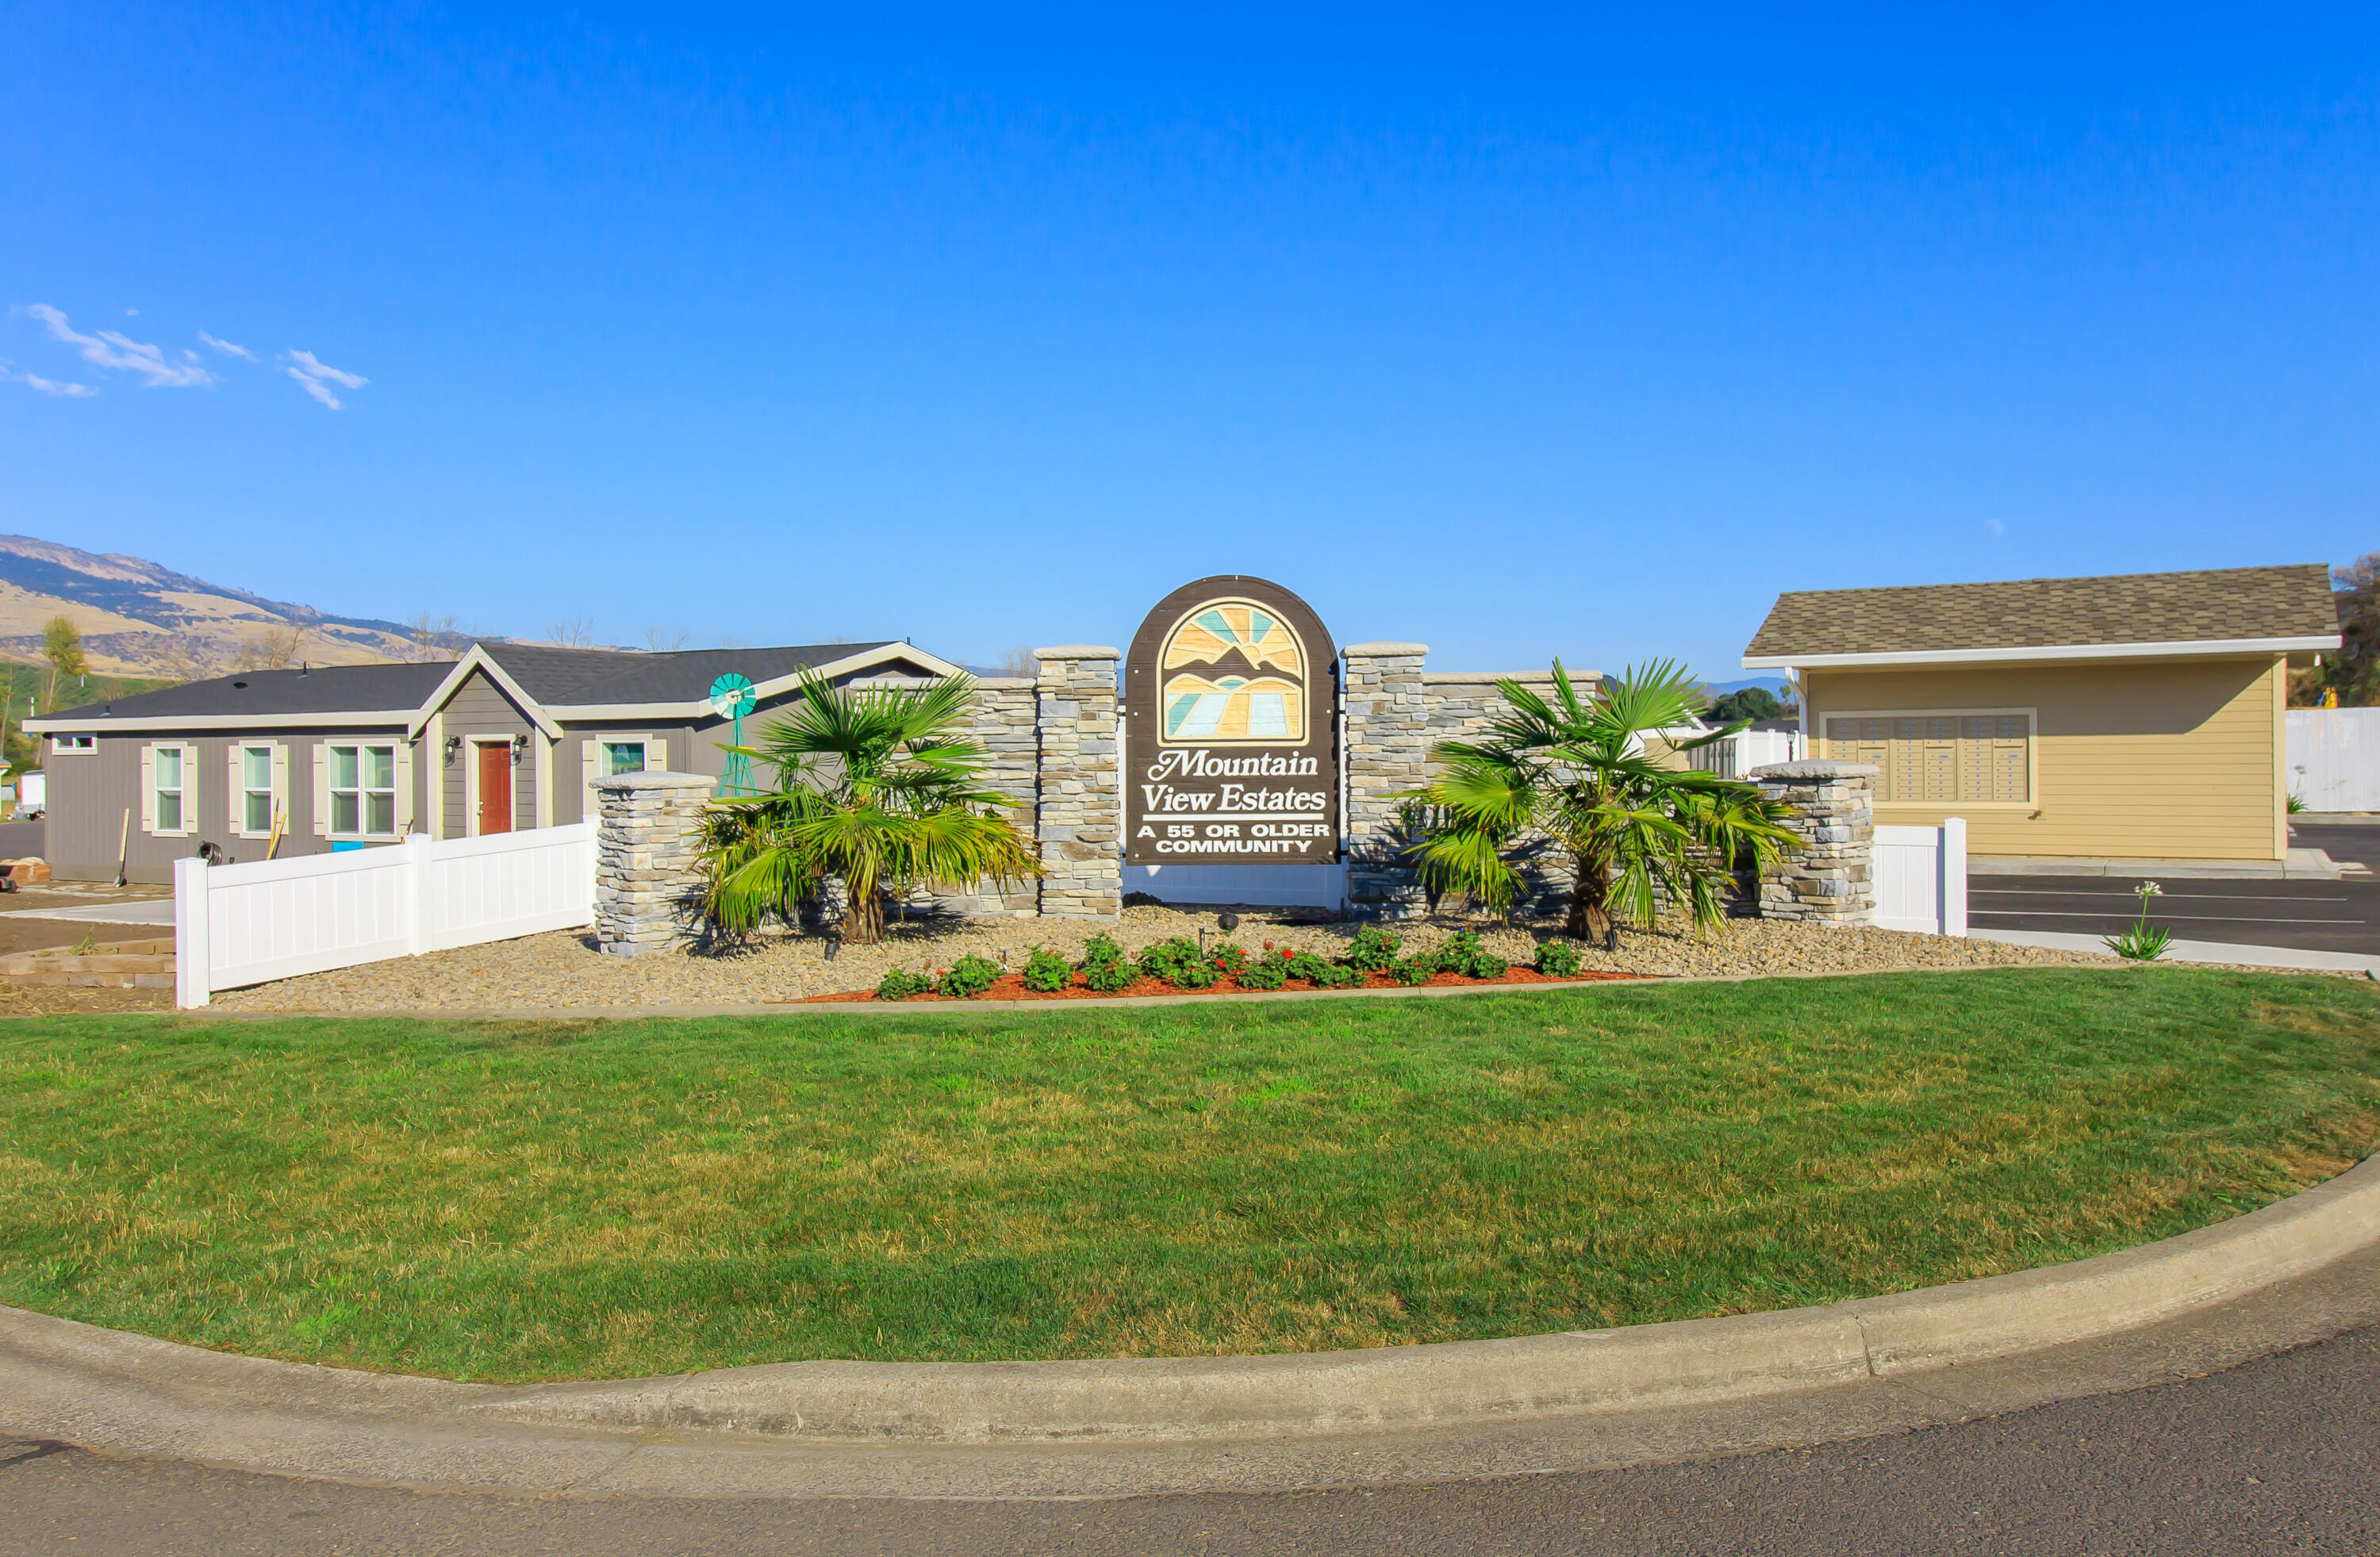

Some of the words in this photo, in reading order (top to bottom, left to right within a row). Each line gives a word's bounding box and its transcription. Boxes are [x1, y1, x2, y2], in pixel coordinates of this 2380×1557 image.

[1147, 750, 1319, 781] Mountain
[1141, 784, 1215, 811] View
[1217, 783, 1326, 811] Estates
[1136, 825, 1156, 838] A
[1167, 824, 1195, 838] 55
[1205, 824, 1240, 838] OR
[1250, 823, 1330, 837] OLDER
[1155, 839, 1313, 853] COMMUNITY
